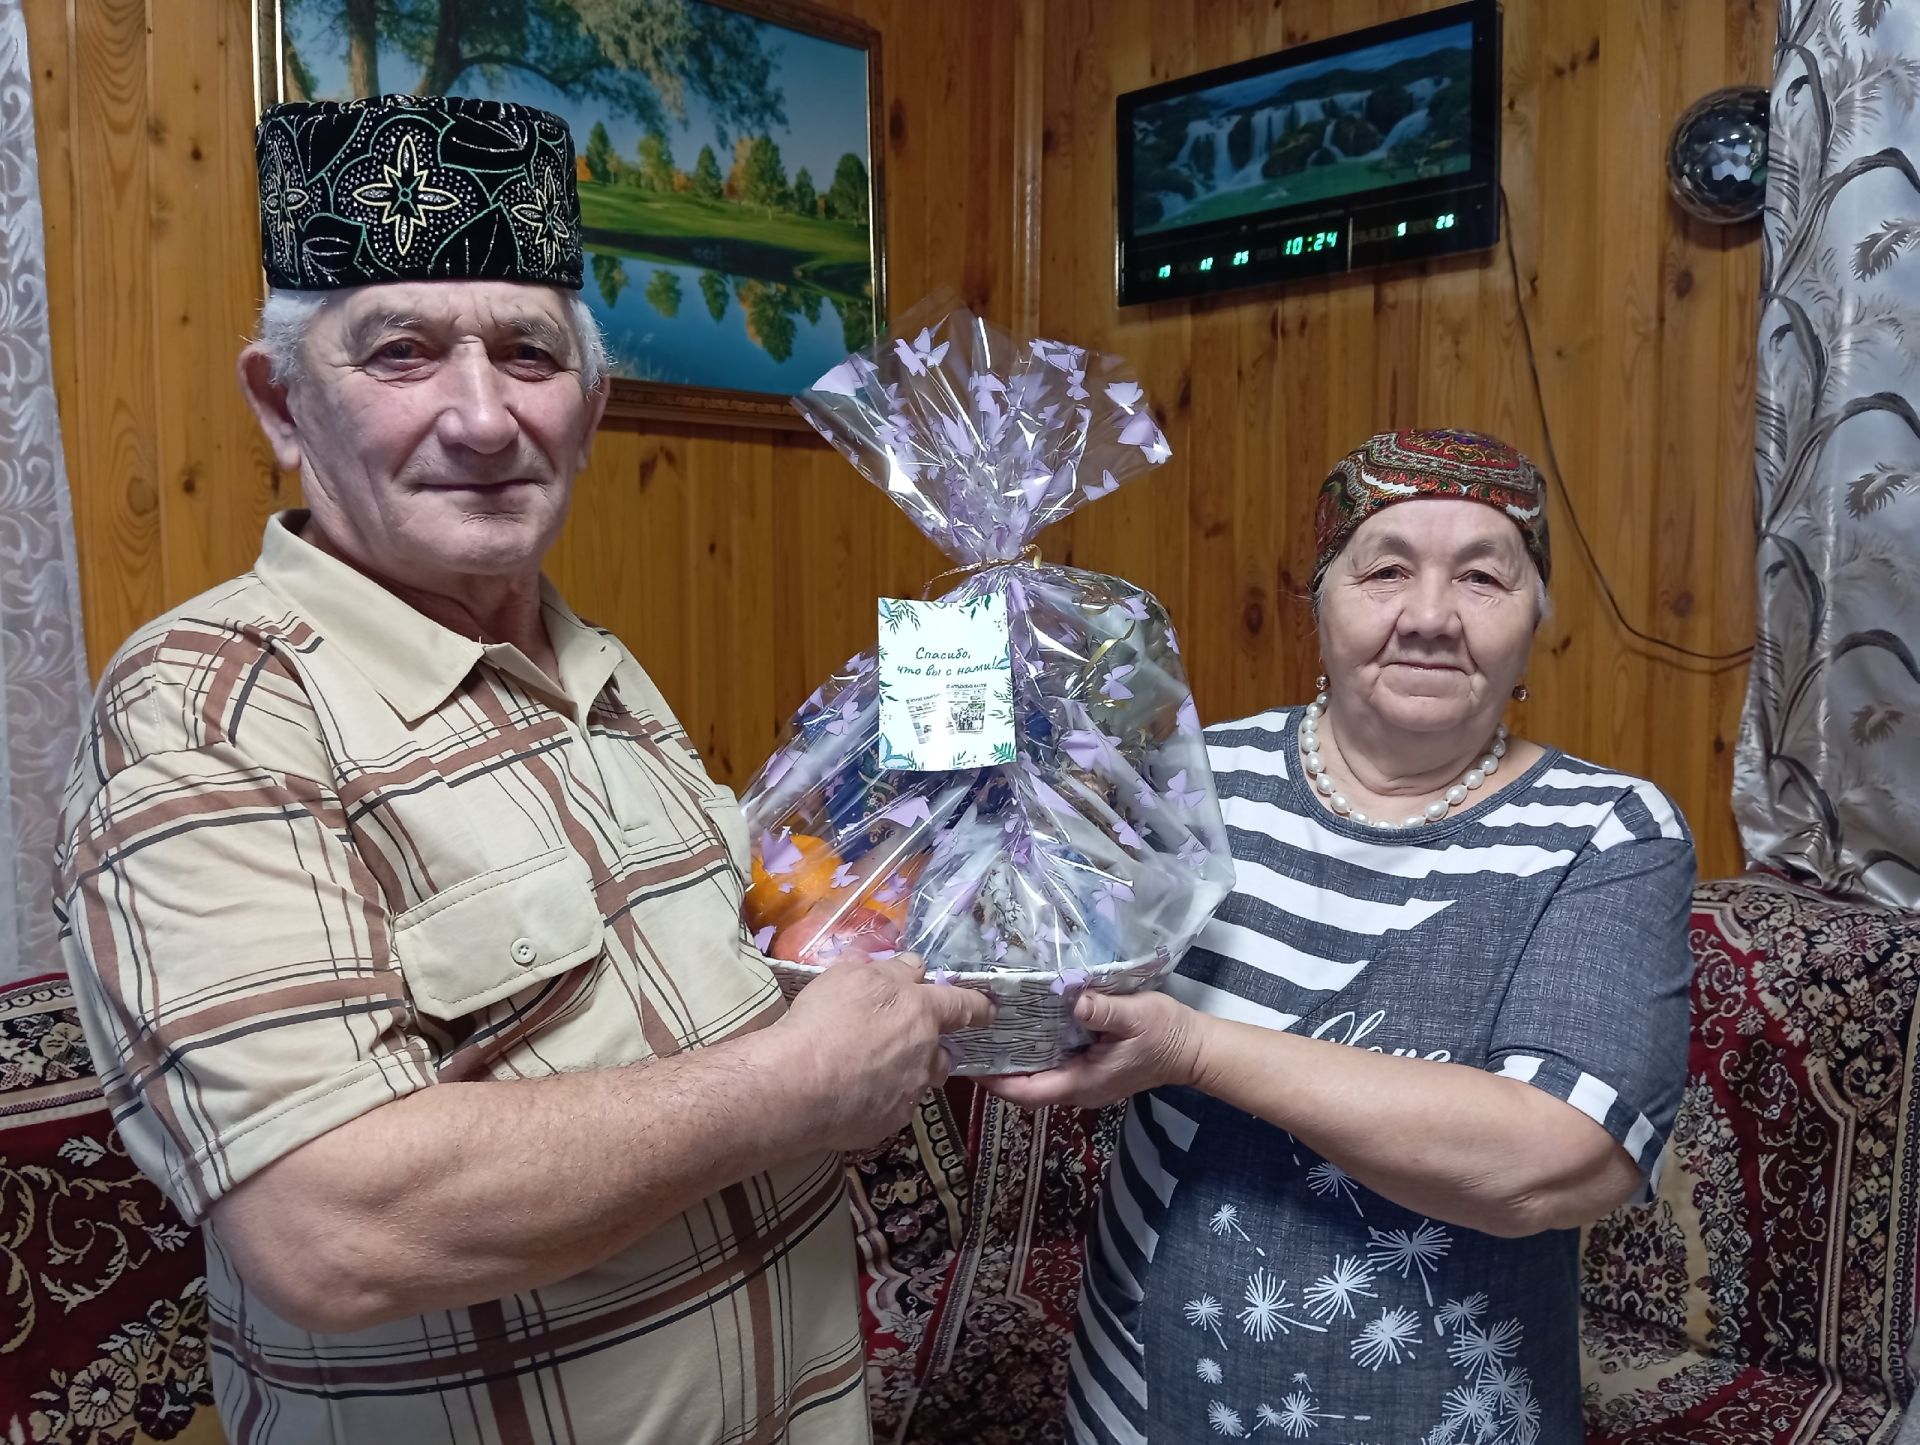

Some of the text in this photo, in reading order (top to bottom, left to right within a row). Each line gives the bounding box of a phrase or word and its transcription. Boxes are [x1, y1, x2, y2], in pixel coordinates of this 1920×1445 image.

[1285, 231, 1338, 255] 10:24
[915, 646, 971, 660] Спасибо,
[897, 655, 998, 676] что вы с нами!
